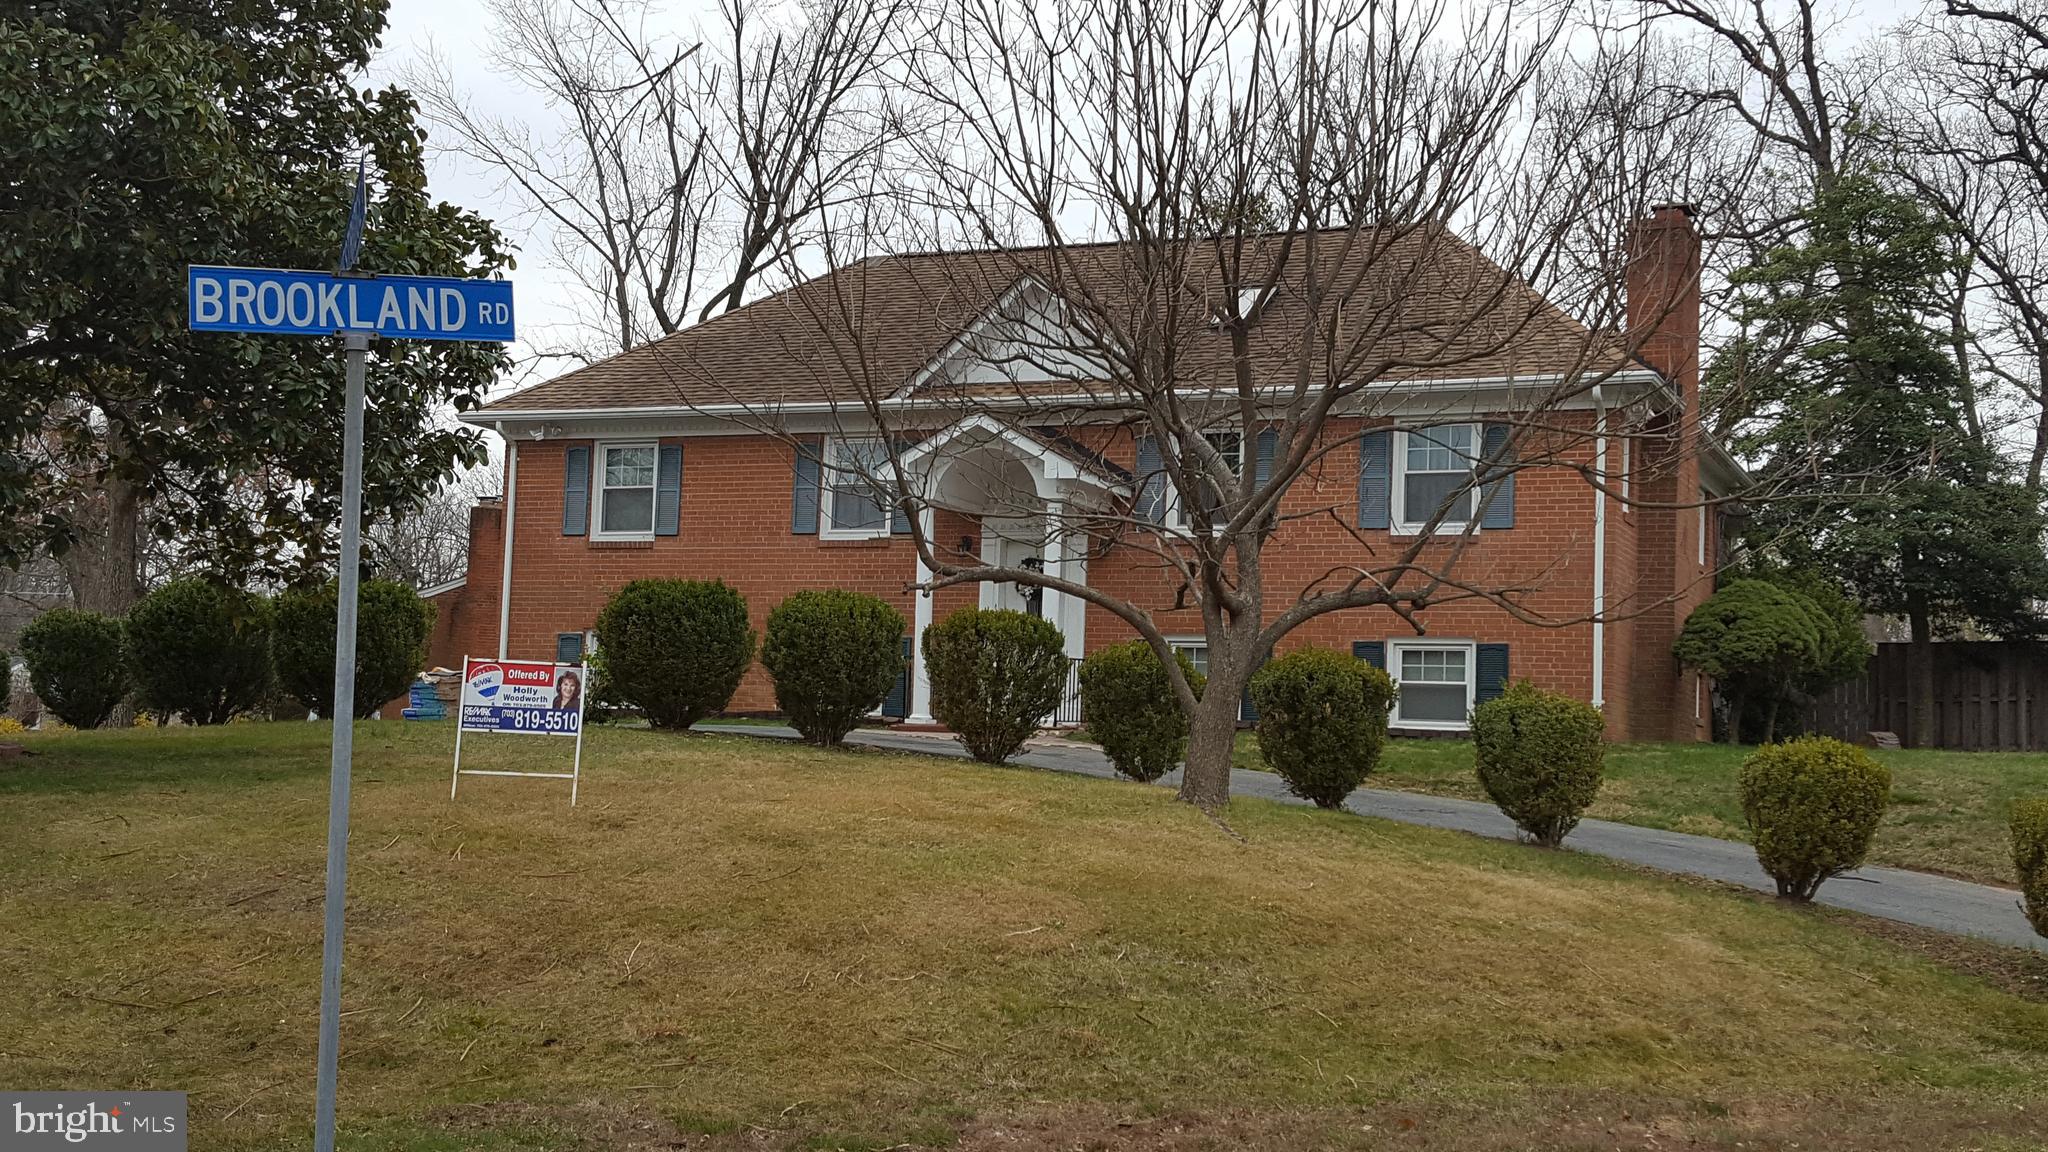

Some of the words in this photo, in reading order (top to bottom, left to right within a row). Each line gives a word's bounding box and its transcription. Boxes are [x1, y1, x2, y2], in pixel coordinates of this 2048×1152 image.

[195, 277, 467, 332] BROOKLAND
[478, 302, 509, 326] RD
[508, 669, 538, 680] Offered
[539, 671, 550, 683] By
[513, 686, 538, 695] Holly
[503, 693, 548, 703] Woodworth
[464, 706, 493, 716] RE/MAX
[463, 715, 500, 723] Executives
[514, 709, 578, 731] 819-5510
